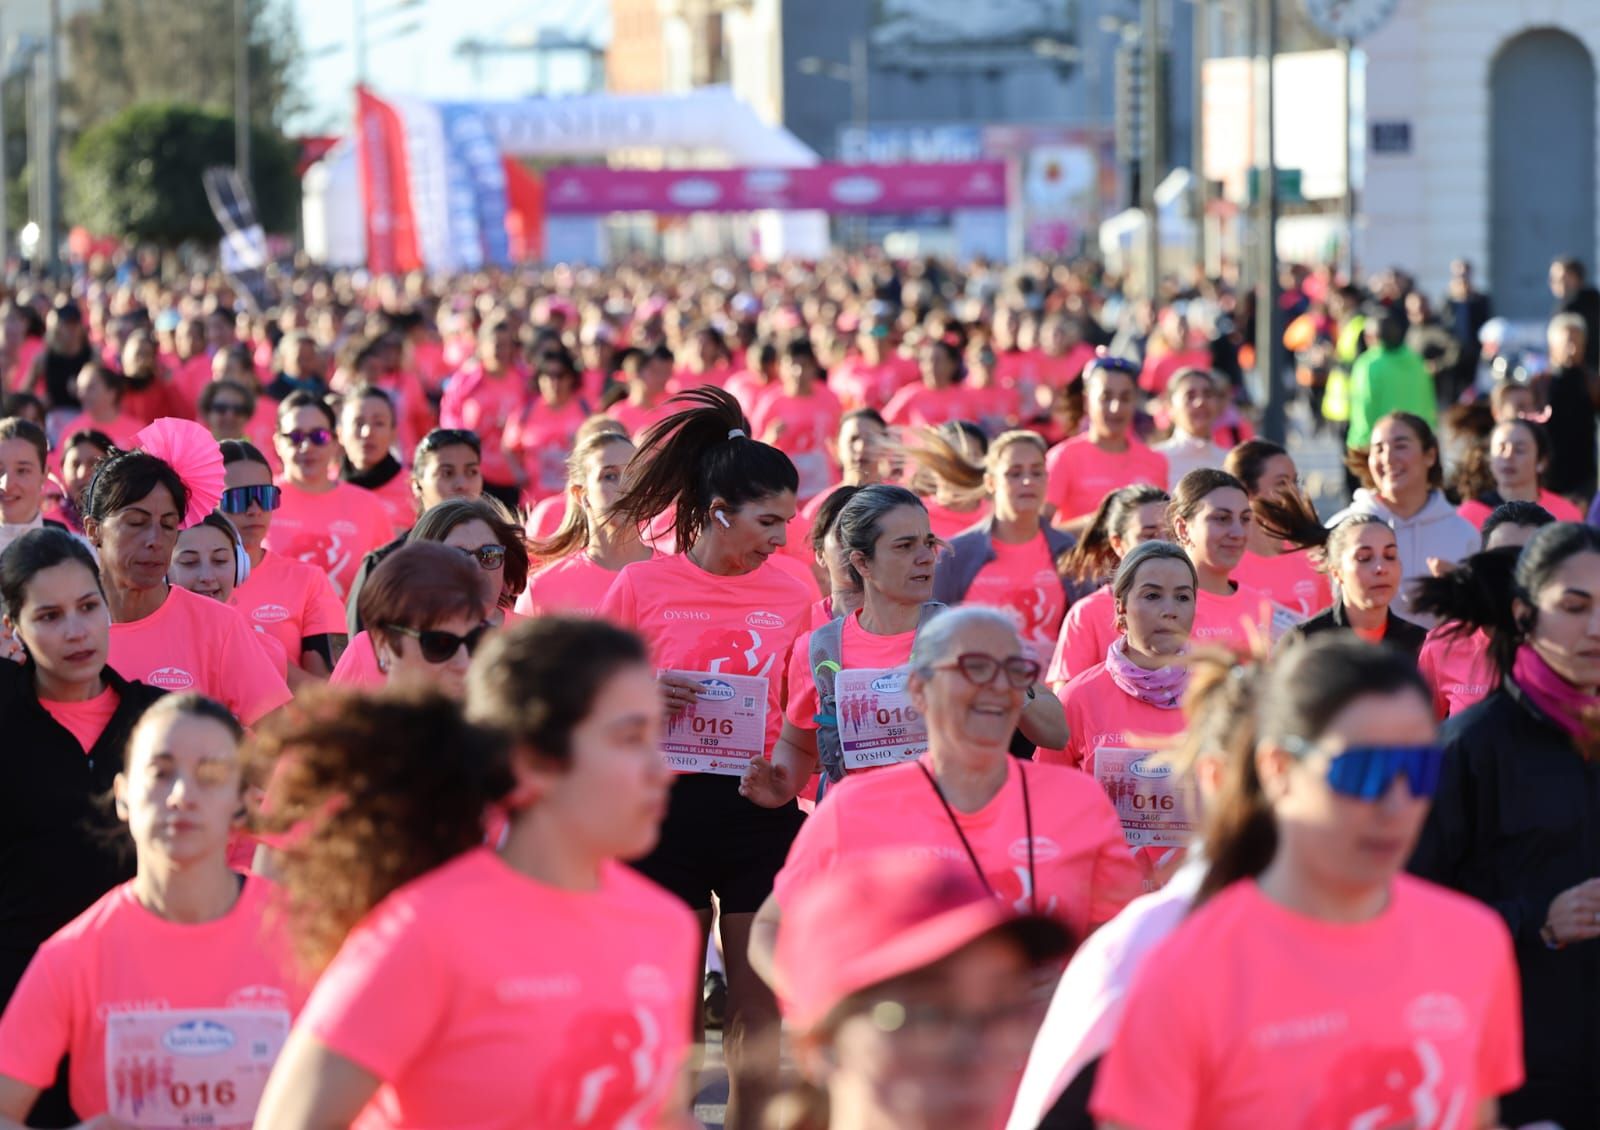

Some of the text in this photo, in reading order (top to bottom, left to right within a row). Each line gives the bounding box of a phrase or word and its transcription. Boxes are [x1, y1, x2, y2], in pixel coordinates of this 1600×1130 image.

[664, 610, 710, 621] OYSHO
[152, 675, 190, 685] ASTURIANA
[876, 705, 919, 726] 016
[692, 716, 734, 735] 016
[700, 738, 719, 746] 1839
[1093, 733, 1127, 746] OYSH
[856, 750, 891, 761] OYSHO
[1132, 794, 1174, 810] 016
[170, 1080, 236, 1109] 016
